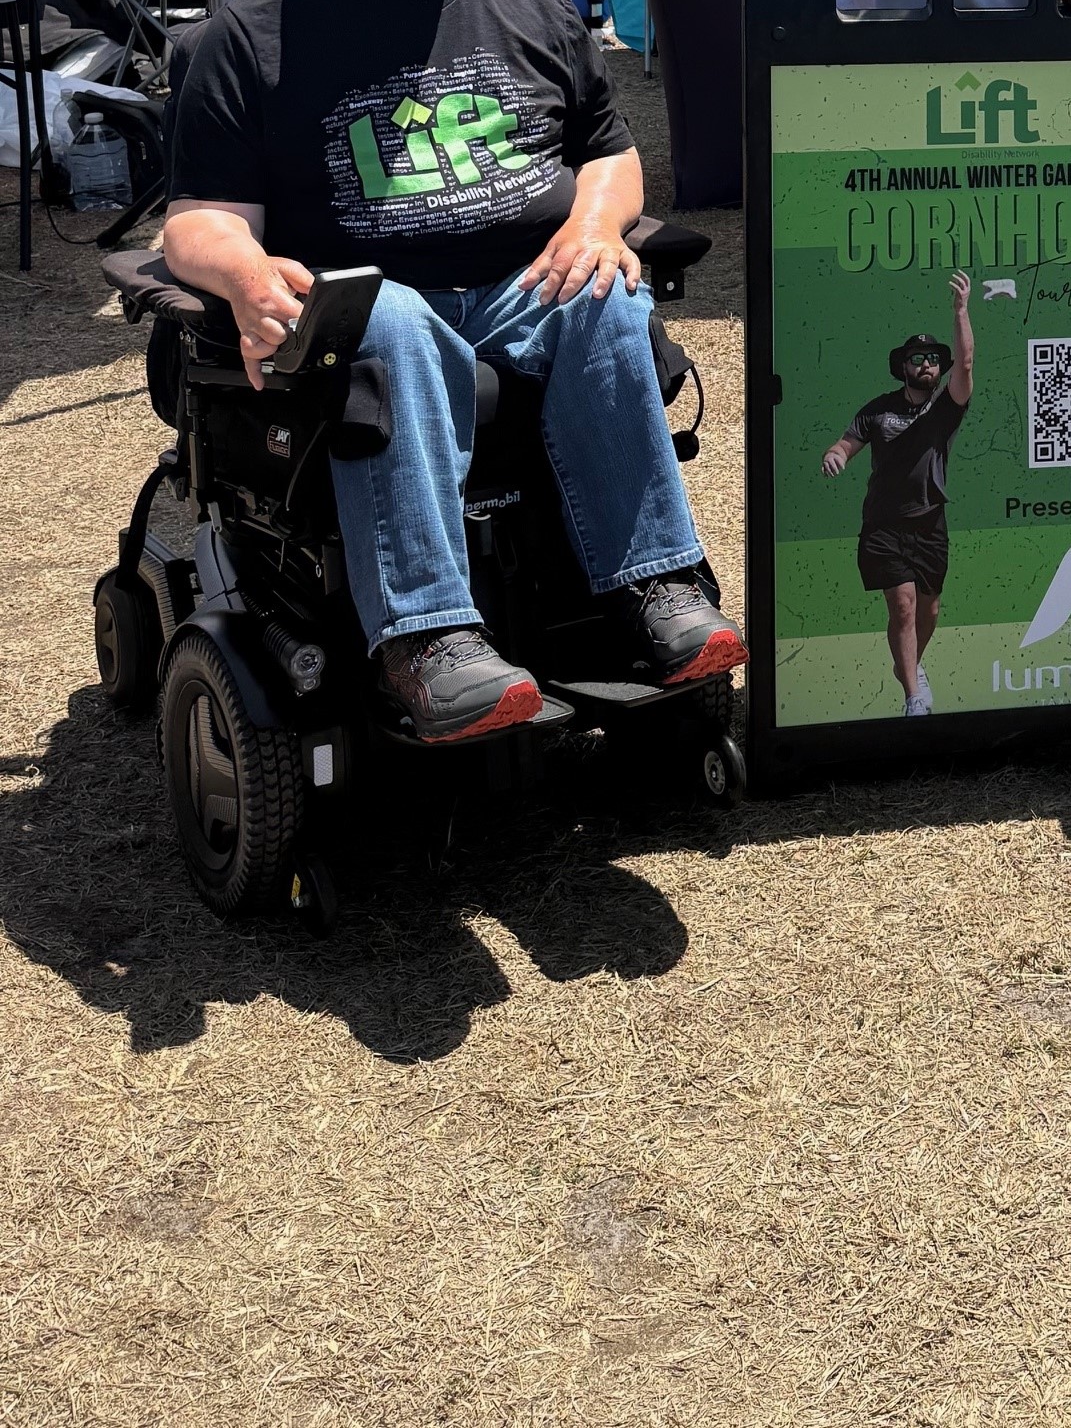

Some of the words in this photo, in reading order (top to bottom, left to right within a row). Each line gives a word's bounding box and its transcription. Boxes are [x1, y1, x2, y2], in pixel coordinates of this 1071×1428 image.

[926, 71, 1041, 145] Lift
[349, 93, 532, 199] Lift
[961, 149, 1001, 160] Disability
[1004, 149, 1040, 159] Network
[426, 186, 492, 209] Disability
[493, 166, 542, 193] Network
[844, 166, 881, 193] 4TH
[887, 165, 962, 191] ANNUAL
[967, 162, 1038, 189] WINTER
[464, 490, 521, 513] permobil
